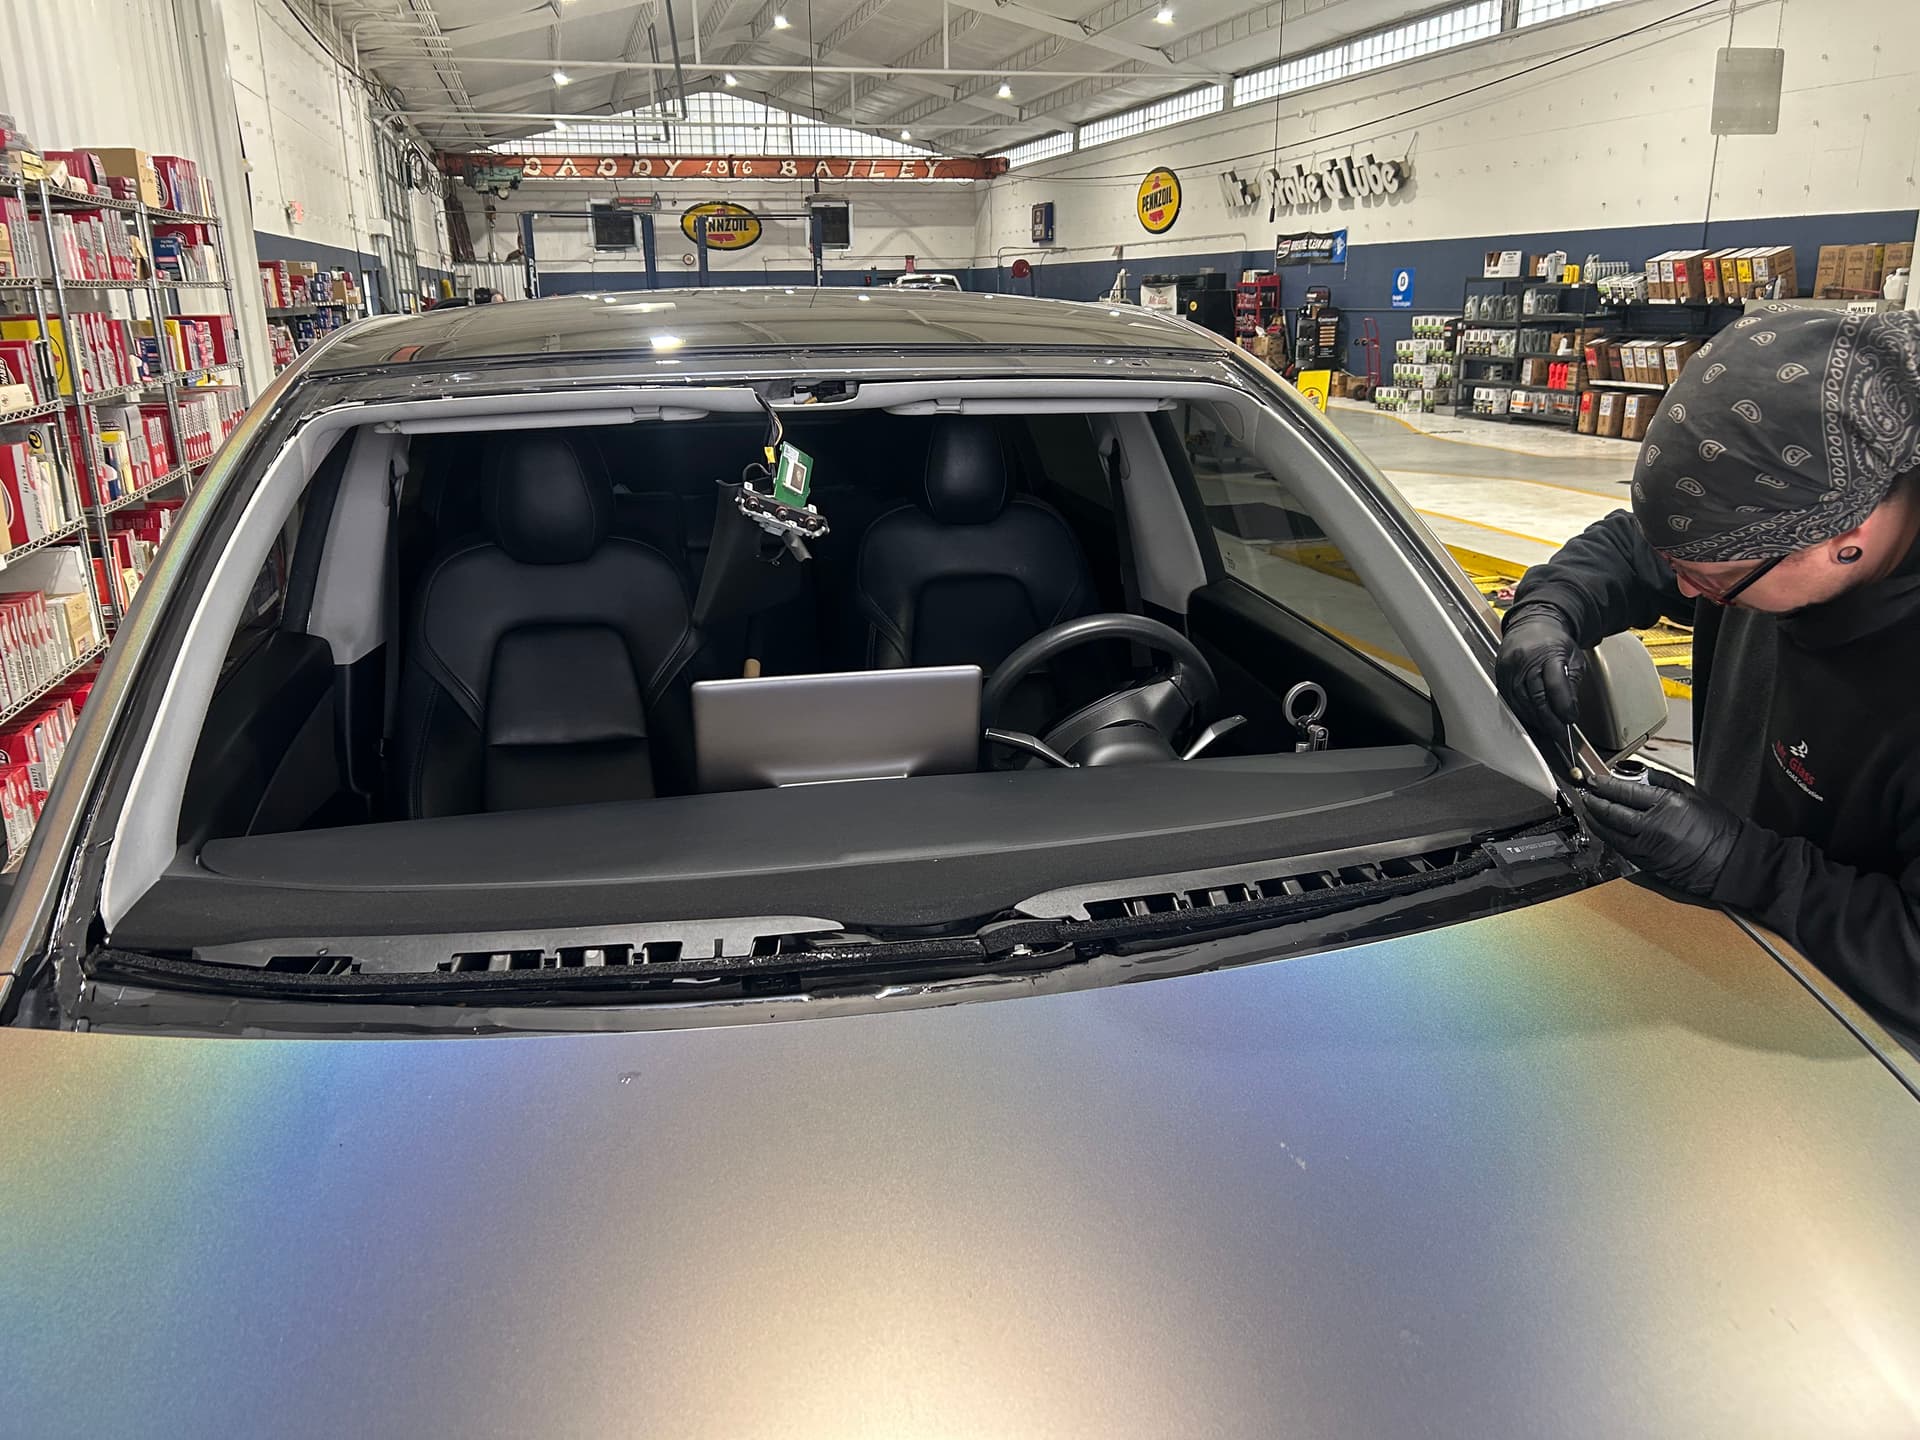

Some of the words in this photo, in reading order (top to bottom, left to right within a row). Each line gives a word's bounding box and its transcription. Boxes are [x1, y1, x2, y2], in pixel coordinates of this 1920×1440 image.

[701, 160, 753, 175] 1976
[779, 160, 942, 178] BAILEY
[1340, 155, 1400, 198] Lube
[1141, 185, 1174, 214] PENNZOIL
